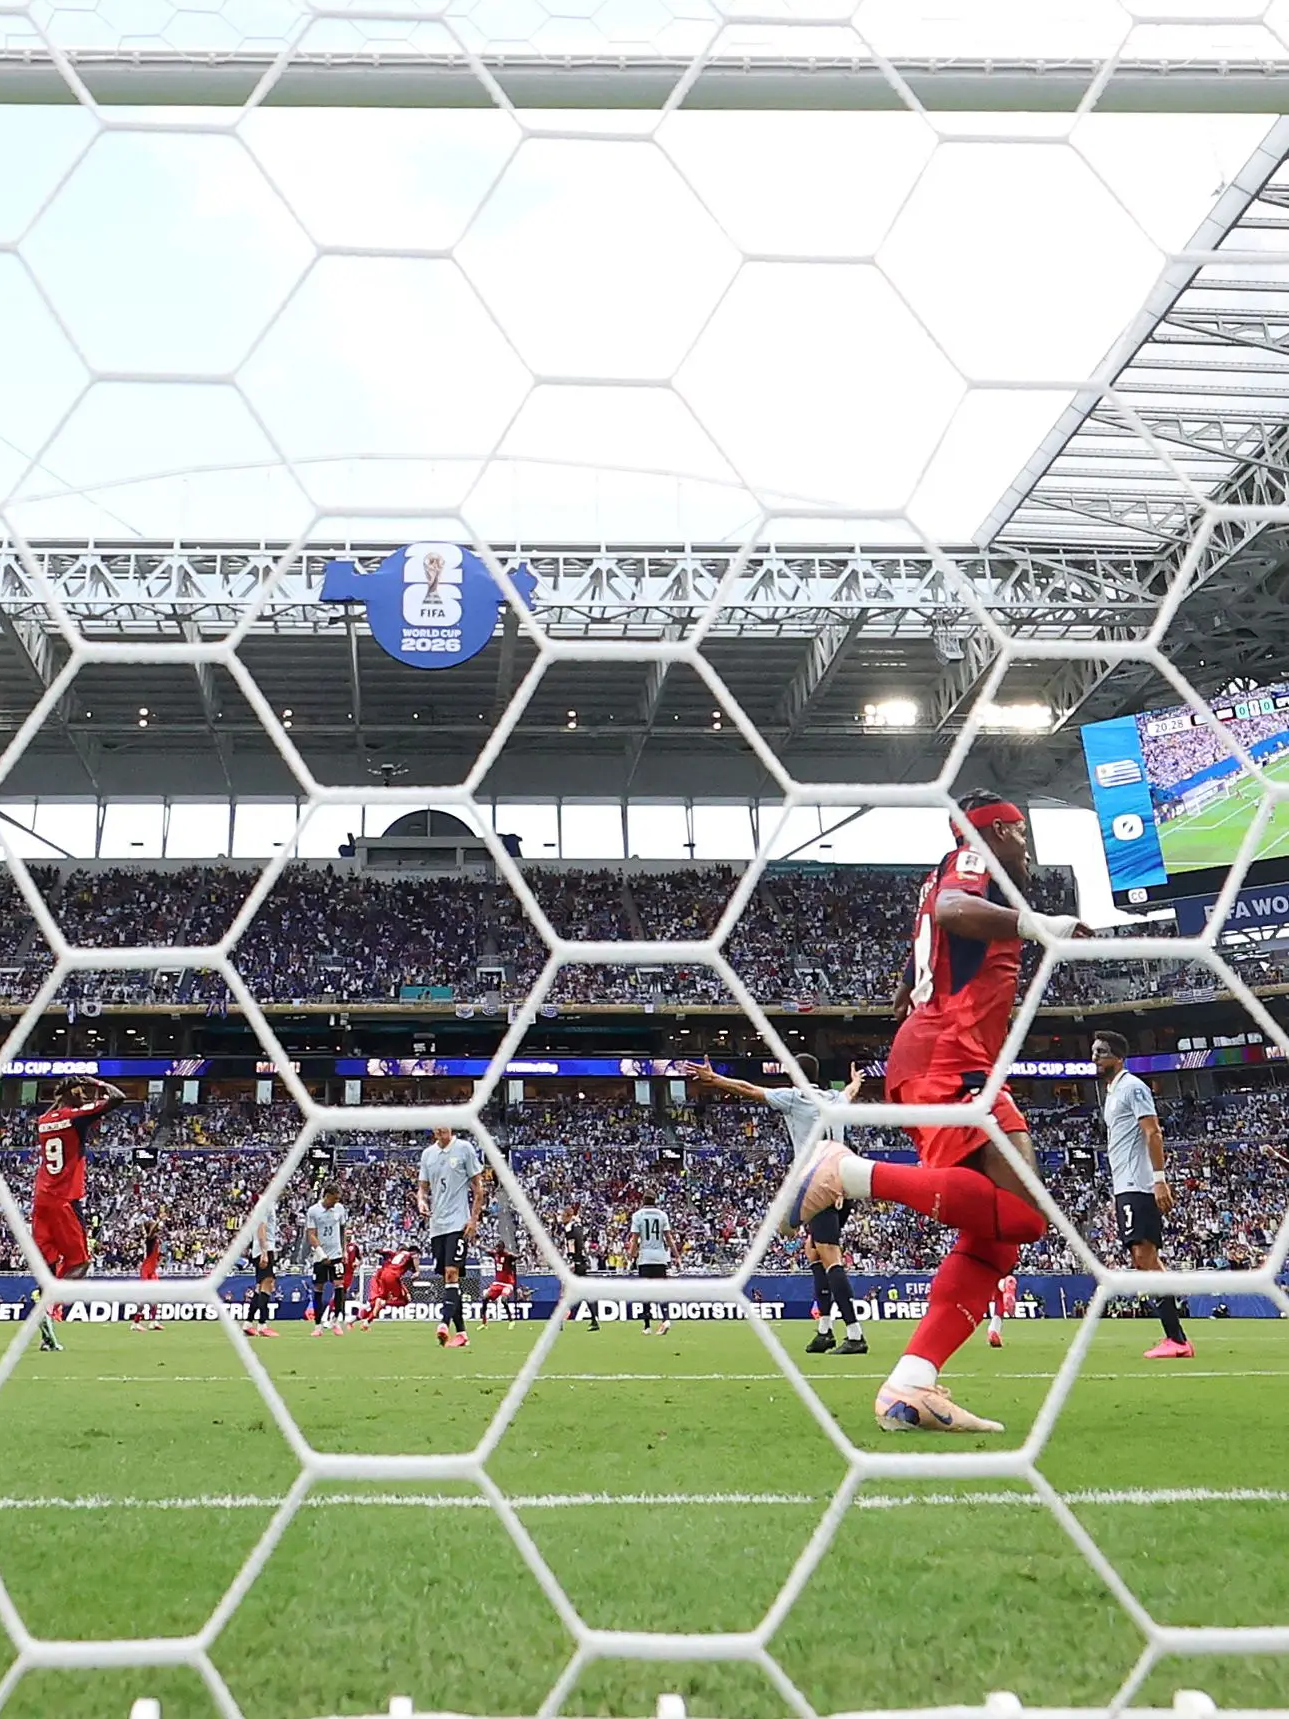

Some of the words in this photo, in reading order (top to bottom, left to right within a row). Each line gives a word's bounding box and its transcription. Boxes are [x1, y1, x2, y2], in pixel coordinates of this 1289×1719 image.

[420, 608, 446, 618] FIFA
[402, 629, 440, 638] WORLD
[440, 629, 462, 638] CUP
[400, 638, 462, 652] 2026
[1130, 891, 1146, 901] CC
[24, 1062, 52, 1074] CUP
[51, 1061, 98, 1074] 2026
[1038, 1062, 1064, 1075] CUP
[1064, 1062, 1097, 1075] 202
[45, 1137, 64, 1175] 9
[440, 1178, 447, 1193] 5
[643, 1218, 660, 1241] 14
[456, 1236, 465, 1256] 5
[66, 1300, 119, 1322] ADI
[575, 1300, 628, 1321] ADI
